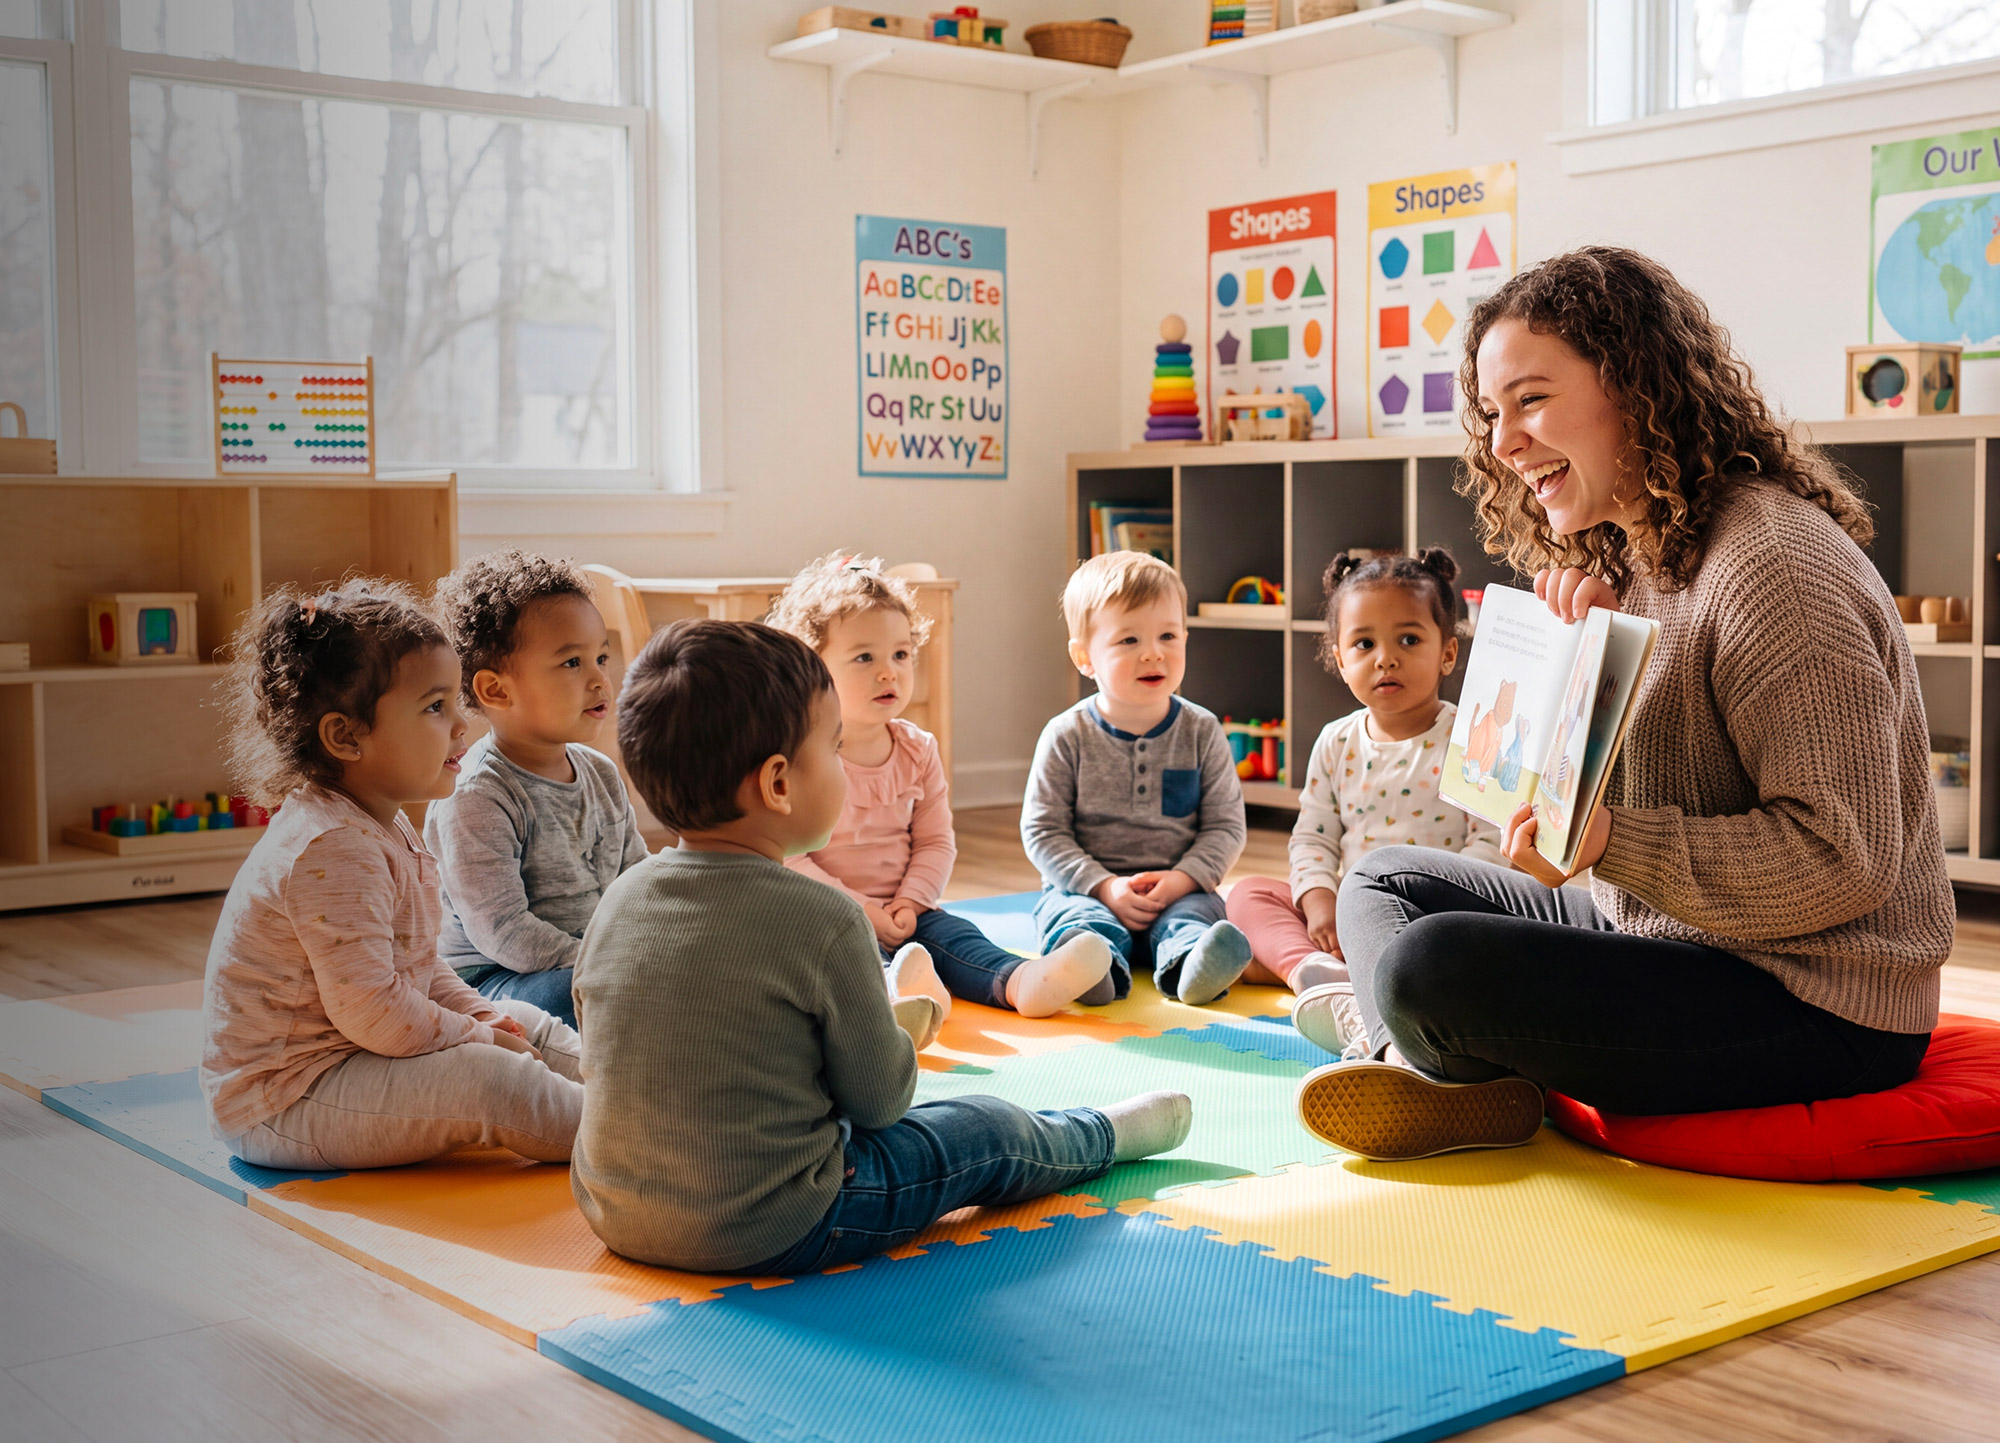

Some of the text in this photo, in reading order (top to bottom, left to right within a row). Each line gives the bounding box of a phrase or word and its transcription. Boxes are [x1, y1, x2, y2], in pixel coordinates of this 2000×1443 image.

[1924, 145, 1983, 176] Our
[1395, 181, 1485, 214] Shapes
[1229, 206, 1312, 241] Shapes
[894, 226, 972, 260] ABC's
